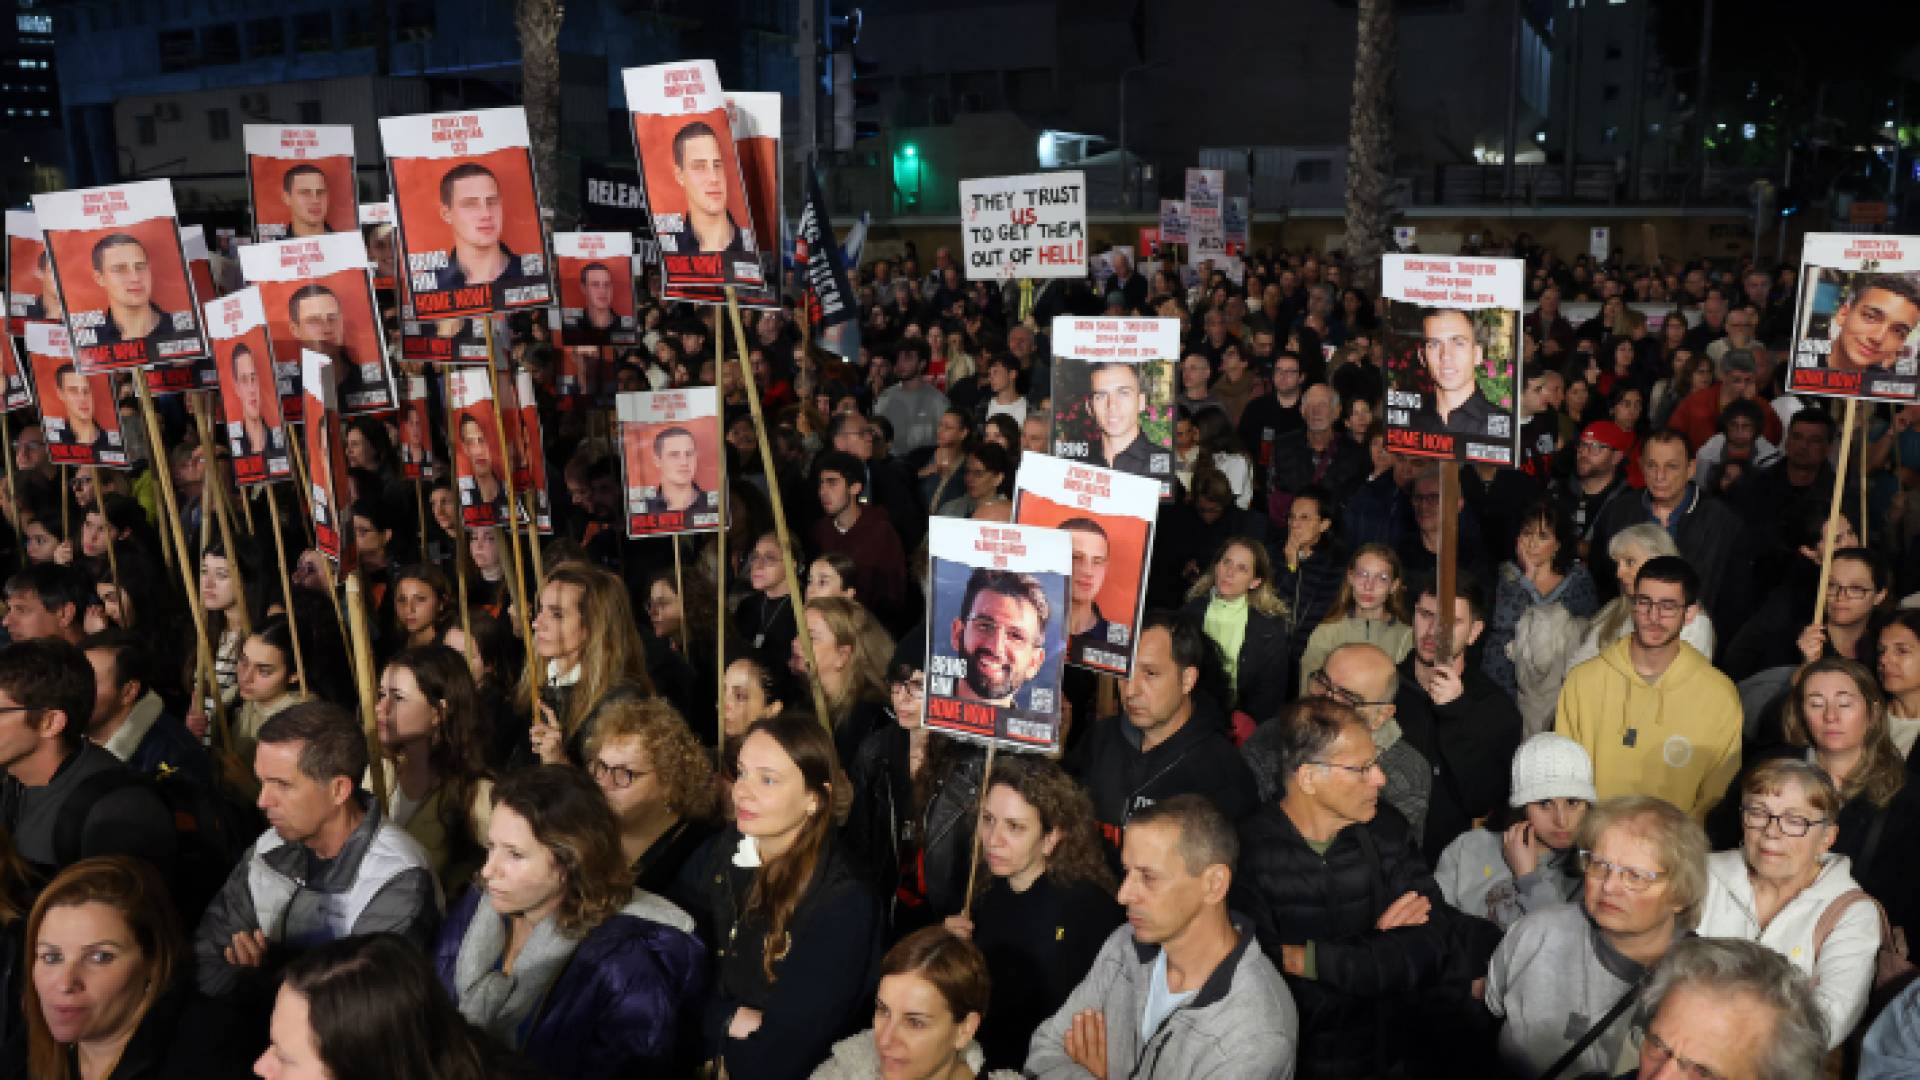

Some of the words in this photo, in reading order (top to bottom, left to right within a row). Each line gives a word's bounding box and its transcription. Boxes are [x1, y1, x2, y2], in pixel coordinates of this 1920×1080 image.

[972, 191, 1015, 211] THEY
[1023, 186, 1080, 206] TRUST
[1010, 208, 1037, 224] US
[969, 226, 994, 243] TO
[999, 224, 1031, 240] GET
[1037, 221, 1083, 238] THEM
[408, 250, 449, 270] BRING
[972, 248, 1004, 267] OUT
[1010, 248, 1034, 265] OF
[1038, 240, 1083, 264] HELL!
[413, 272, 438, 292] HIM
[415, 291, 450, 310] HOME
[453, 285, 492, 307] NOW!
[1387, 389, 1421, 408] BRING
[1387, 409, 1410, 425] HIM
[1056, 441, 1088, 457] BRING
[1387, 429, 1420, 448] HOME
[1422, 433, 1454, 450] NOW!
[932, 656, 967, 678] BRING
[931, 677, 953, 694] HIM
[928, 697, 961, 720] HOME
[963, 703, 996, 725] NOW!
